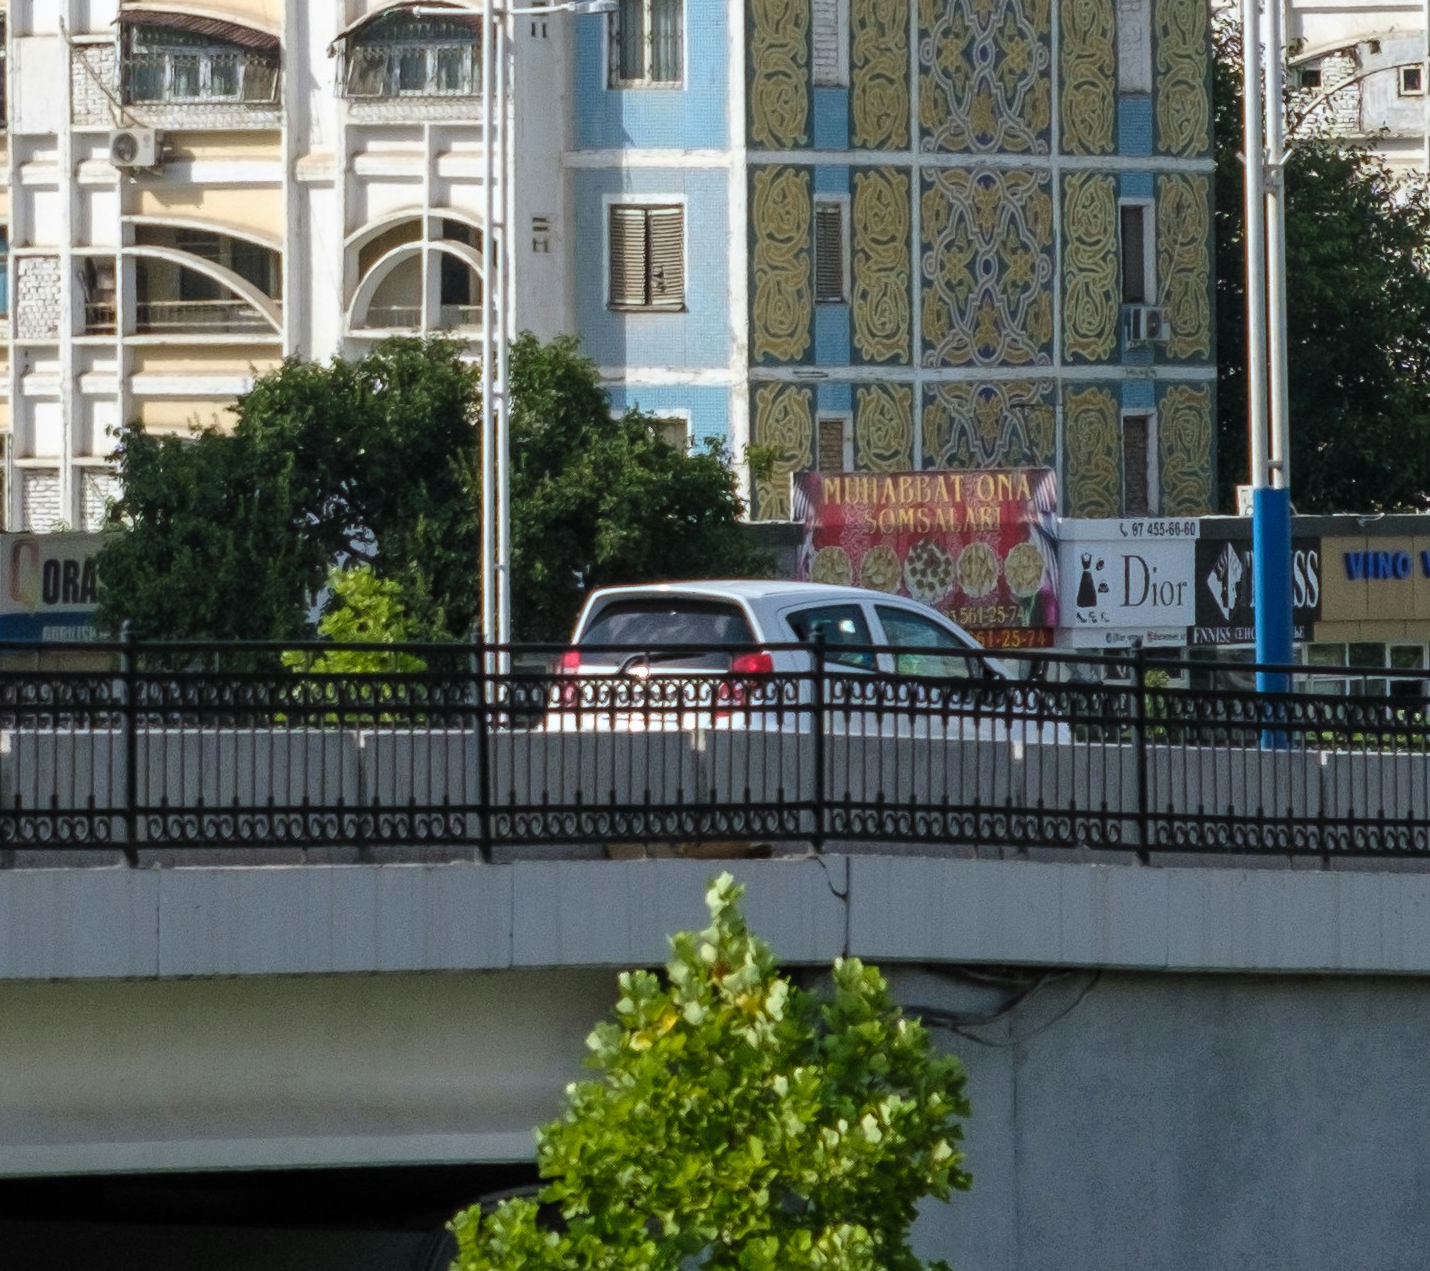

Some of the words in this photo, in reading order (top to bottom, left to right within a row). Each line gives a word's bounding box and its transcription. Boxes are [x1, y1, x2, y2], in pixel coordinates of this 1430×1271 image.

[824, 474, 963, 505] MUHABBAT
[976, 474, 1032, 502] ONA
[865, 506, 1001, 535] SOMSALARI
[1344, 551, 1412, 580] VINO
[1120, 554, 1188, 608] Dior
